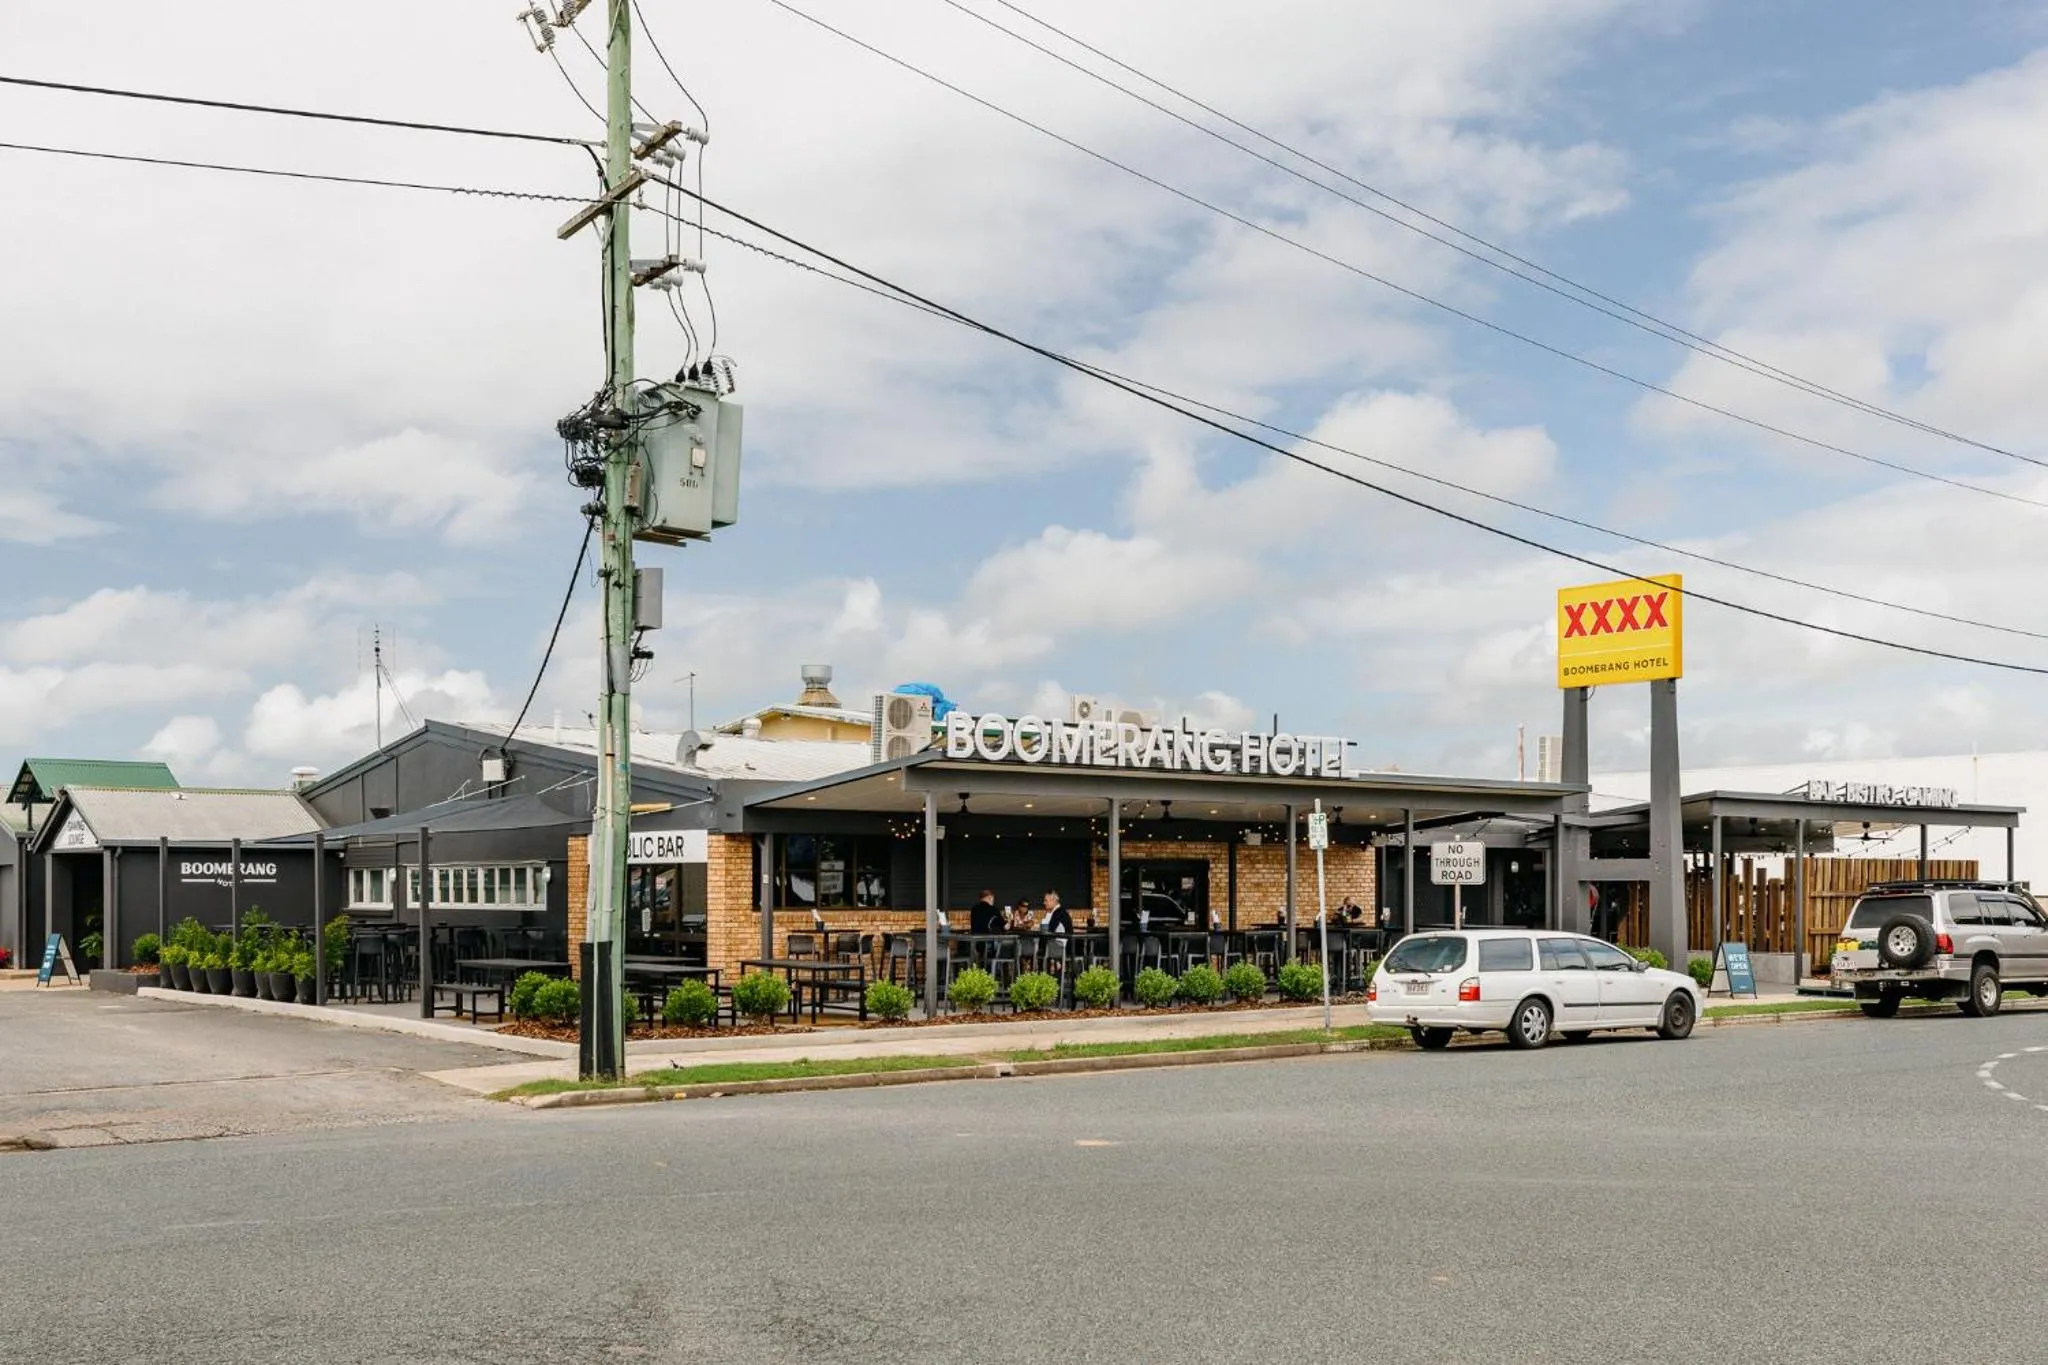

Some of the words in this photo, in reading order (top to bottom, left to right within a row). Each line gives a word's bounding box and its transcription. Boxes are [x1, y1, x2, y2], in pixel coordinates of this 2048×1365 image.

[1564, 592, 1669, 638] XXXX
[1563, 661, 1630, 676] BOOMERANG
[1633, 657, 1669, 669] HOTEL
[946, 711, 1233, 771] BOOMERANG
[1241, 731, 1360, 778] HOTEL
[657, 836, 685, 857] BAR
[1448, 845, 1464, 855] NO
[180, 862, 277, 876] BOOMERANG
[1435, 857, 1480, 868] THROUGH
[1441, 870, 1473, 880] ROAD
